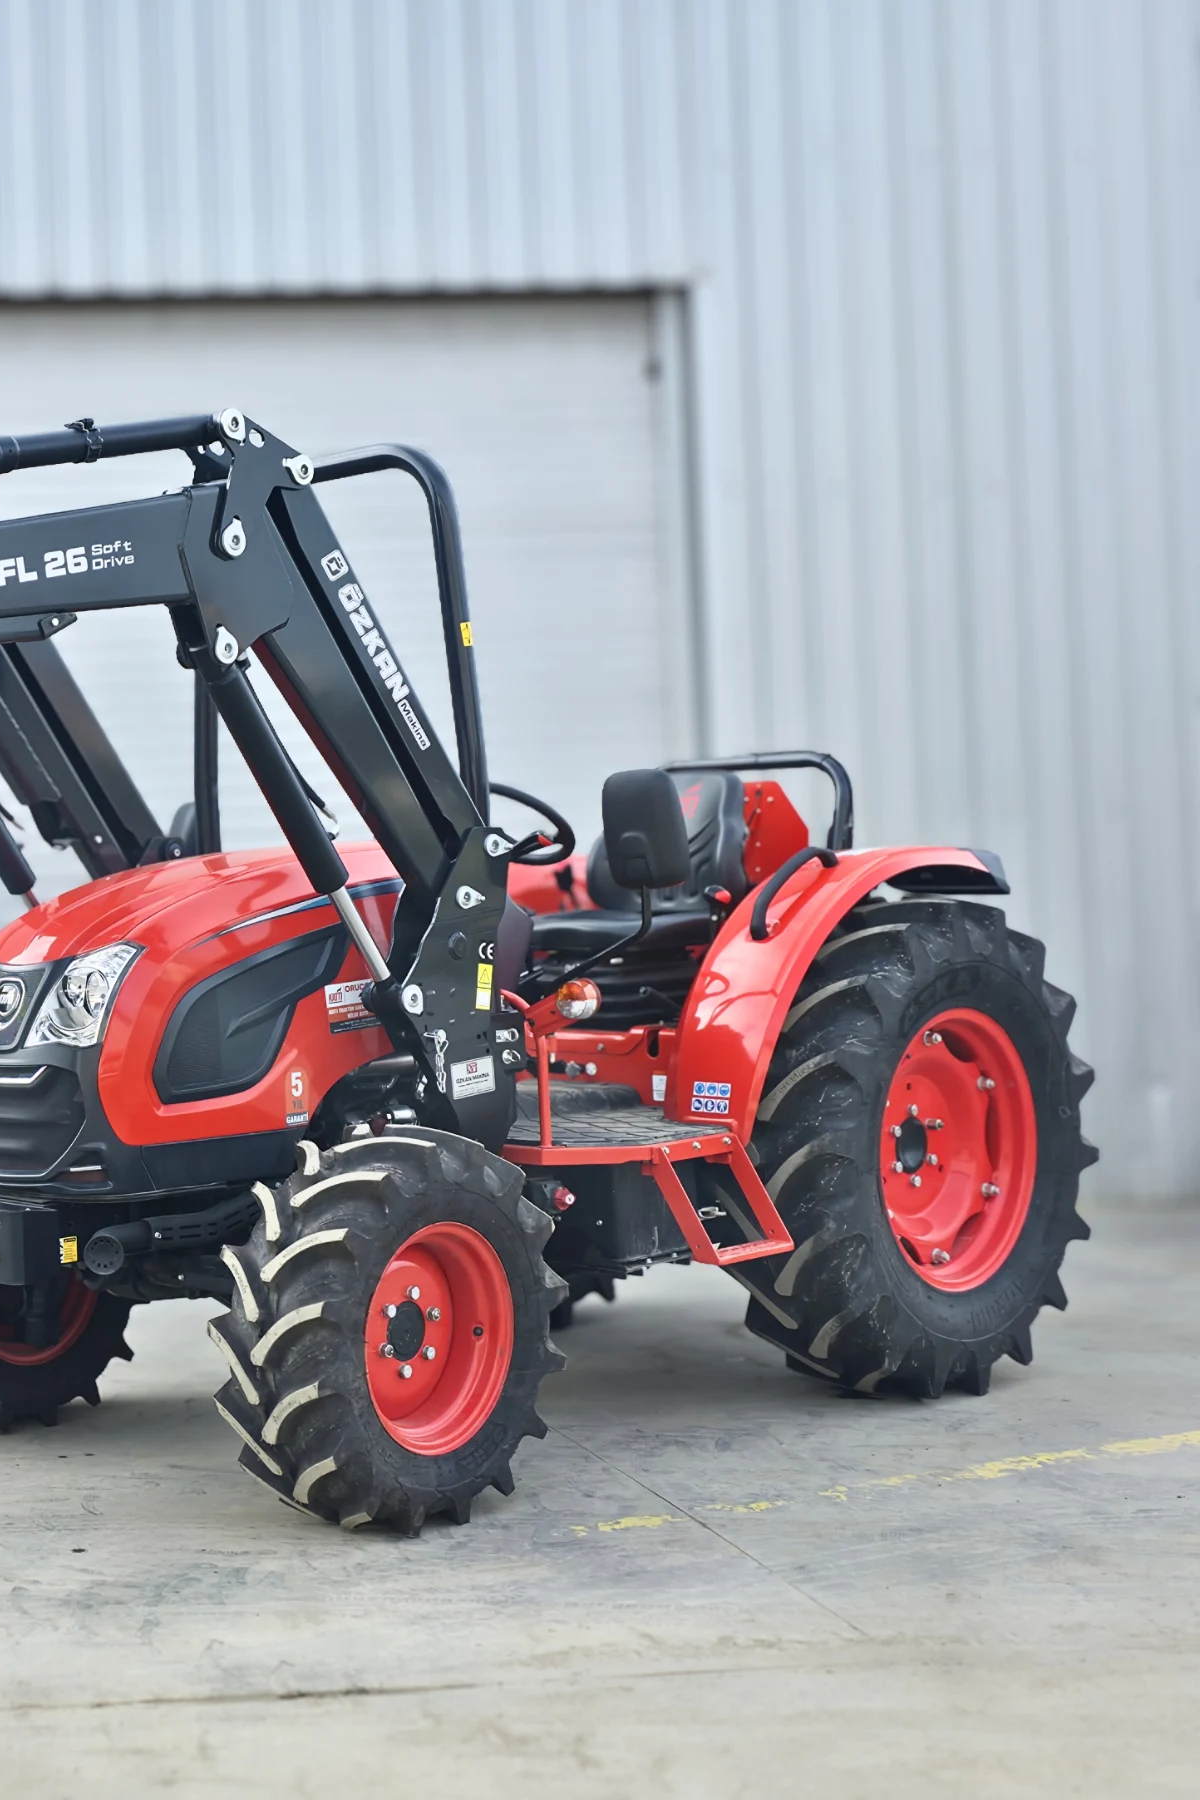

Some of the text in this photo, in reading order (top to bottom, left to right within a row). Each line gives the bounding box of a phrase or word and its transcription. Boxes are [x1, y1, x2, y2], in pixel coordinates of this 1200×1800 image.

[91, 540, 132, 556] Soft
[44, 546, 88, 578] 26
[92, 555, 135, 570] Drive
[338, 583, 410, 703] ÖZKAN
[400, 701, 429, 749] Makina
[478, 942, 495, 960] CE
[291, 1071, 303, 1097] 5
